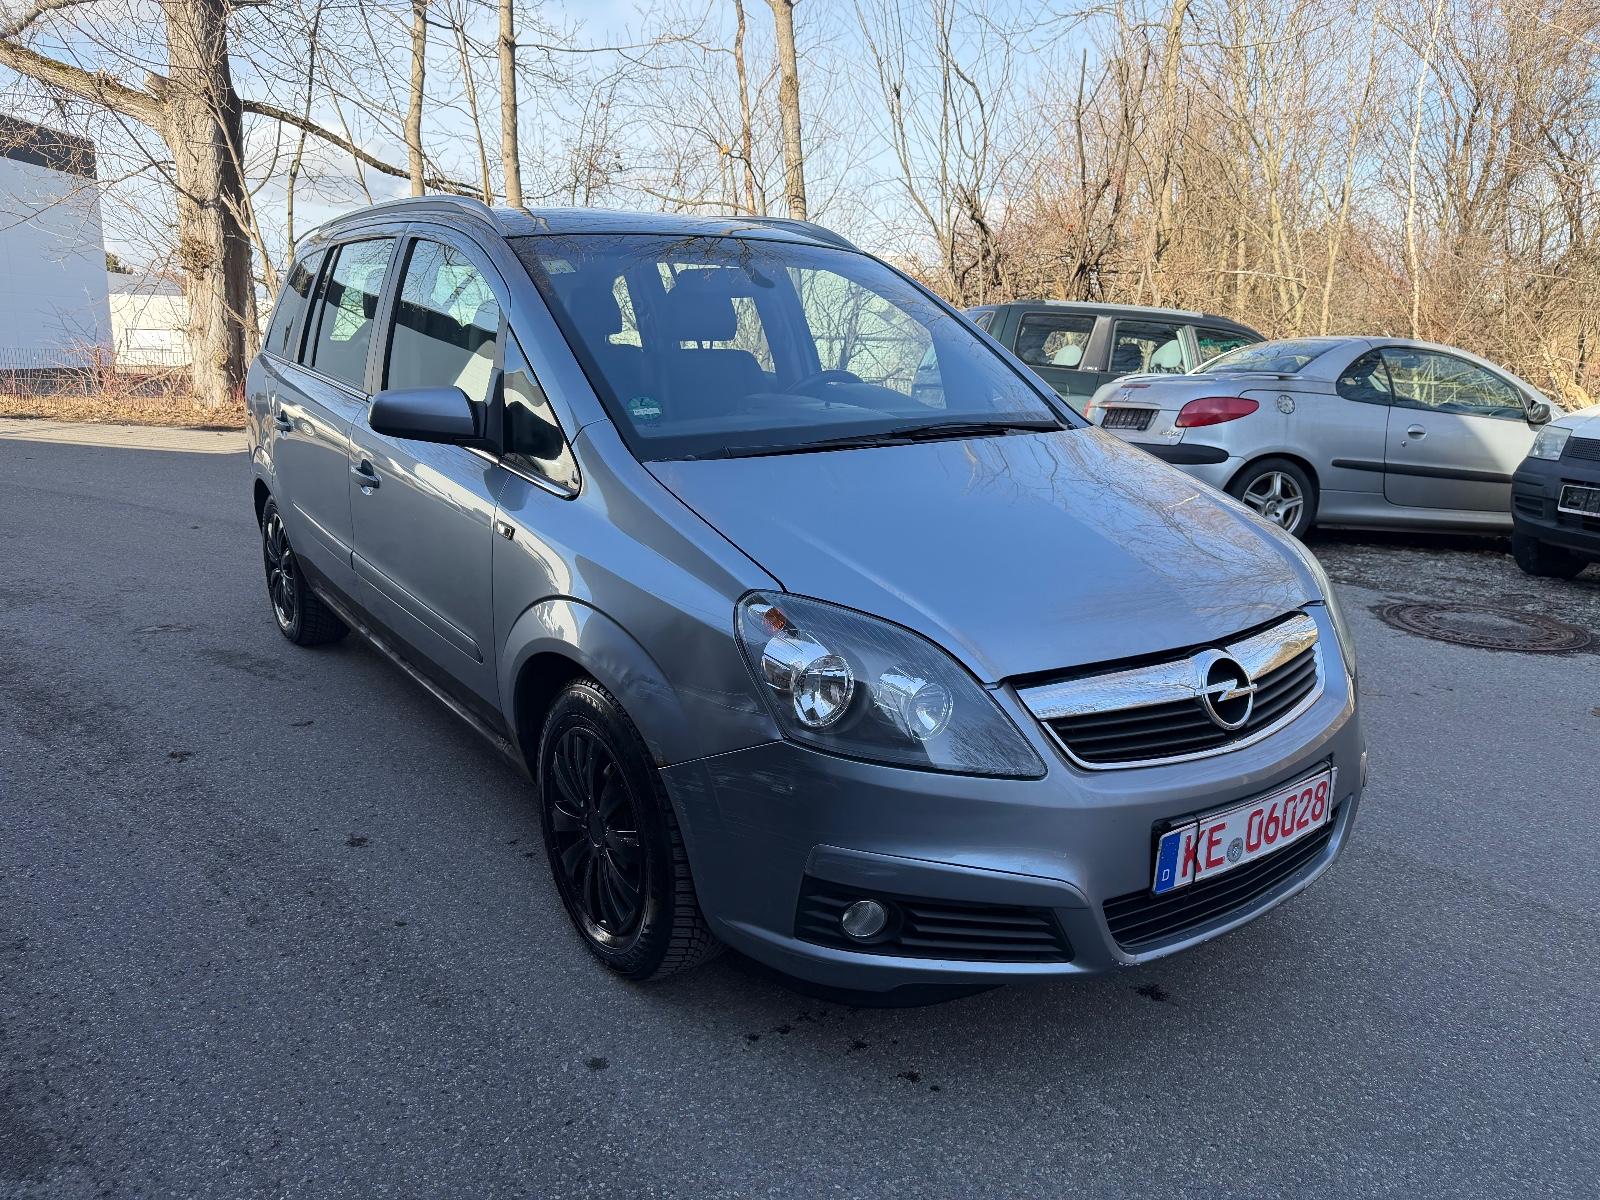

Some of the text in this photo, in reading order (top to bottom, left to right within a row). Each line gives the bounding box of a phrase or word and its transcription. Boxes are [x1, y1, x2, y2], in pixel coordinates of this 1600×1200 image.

[1182, 780, 1328, 878] KE 06028
[1161, 868, 1170, 881] D
